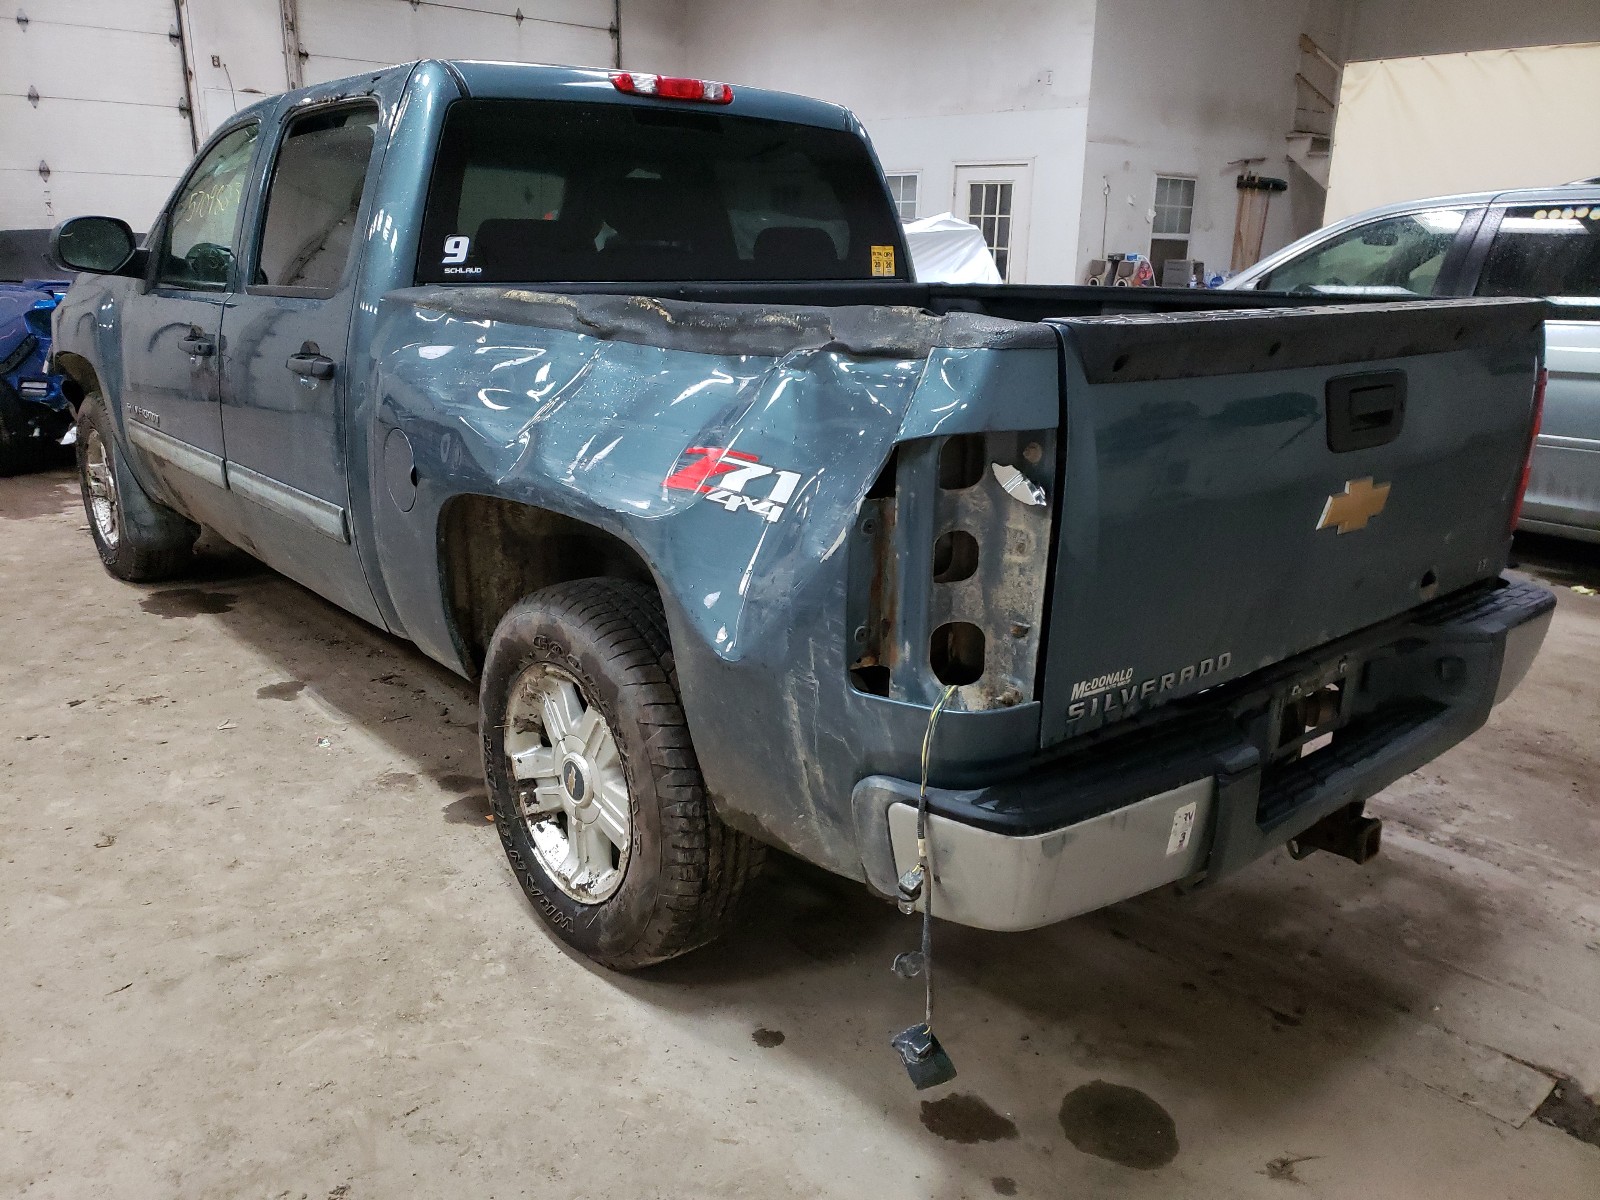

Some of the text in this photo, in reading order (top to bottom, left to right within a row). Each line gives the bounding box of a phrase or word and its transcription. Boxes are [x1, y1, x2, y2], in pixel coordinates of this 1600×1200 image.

[442, 235, 470, 264] 9
[1066, 652, 1232, 723] SILVERADO
[1071, 667, 1133, 701] McDONALD
